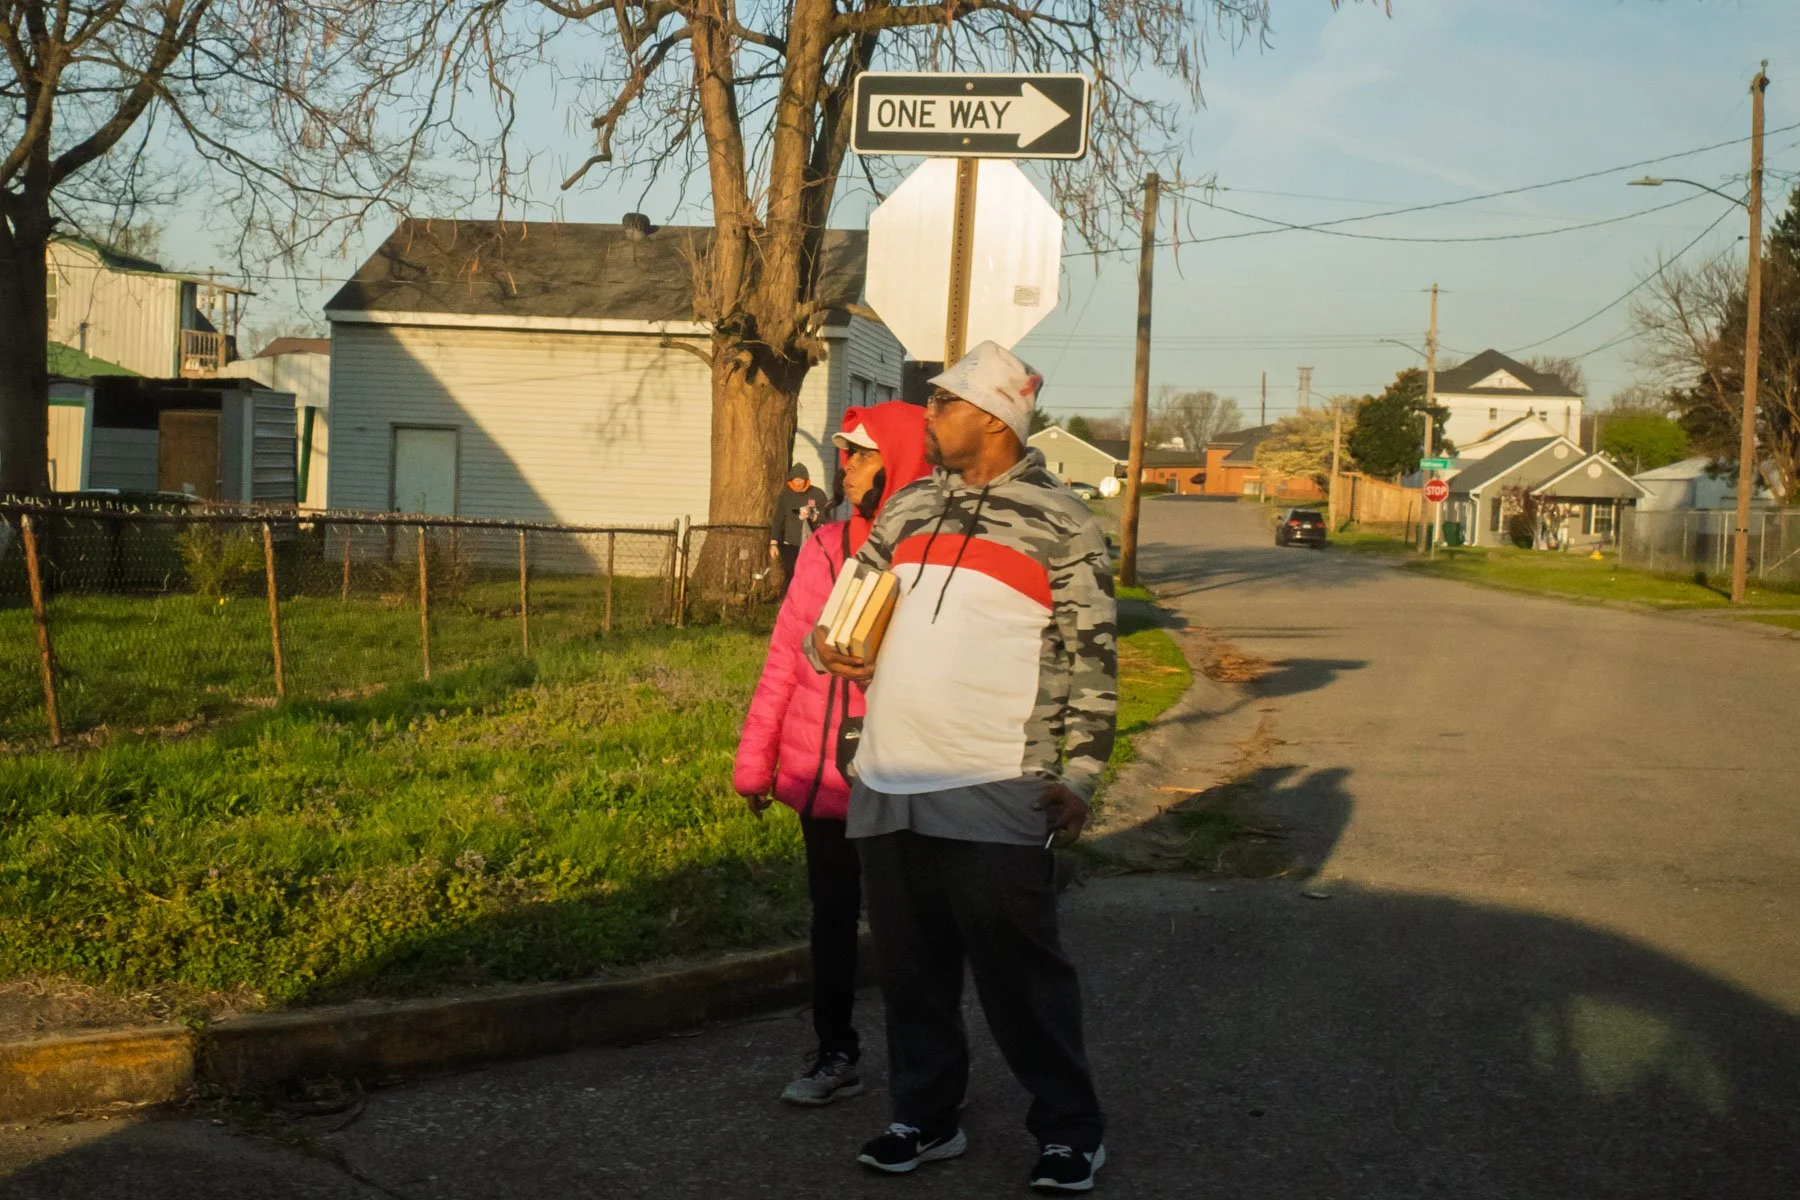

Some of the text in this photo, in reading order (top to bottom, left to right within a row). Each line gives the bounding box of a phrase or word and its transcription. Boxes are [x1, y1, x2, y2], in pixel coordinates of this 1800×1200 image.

[877, 99, 1012, 129] ONE WAY
[1425, 485, 1447, 496] STOP
